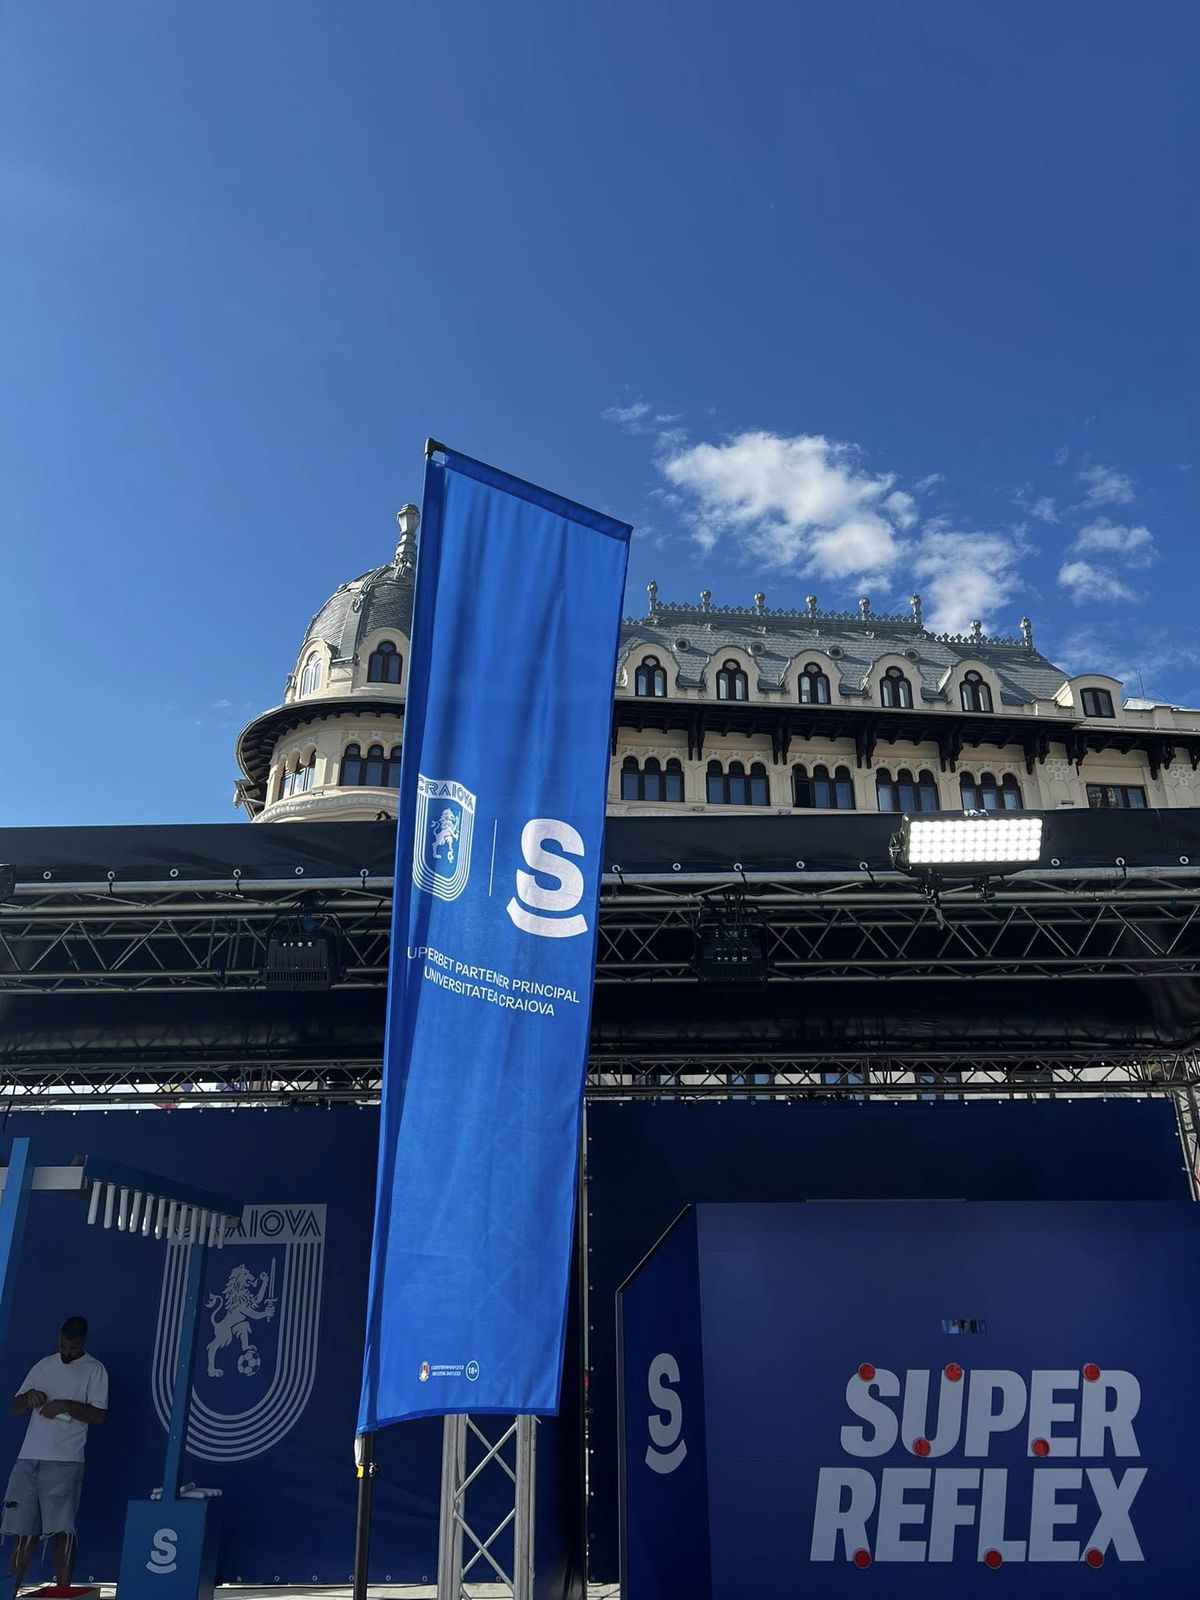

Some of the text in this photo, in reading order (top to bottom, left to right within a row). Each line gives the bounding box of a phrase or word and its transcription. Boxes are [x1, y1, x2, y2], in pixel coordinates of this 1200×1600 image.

[515, 818, 585, 912] S
[407, 946, 581, 1003] UPERBET PARTENER PRINCIPAL
[424, 965, 556, 1017] UNIVERSITATEA CRAIOVA
[647, 1352, 683, 1448] S
[840, 1367, 1142, 1458] SUPER
[150, 1528, 178, 1565] S
[810, 1467, 1149, 1562] REFLEX
